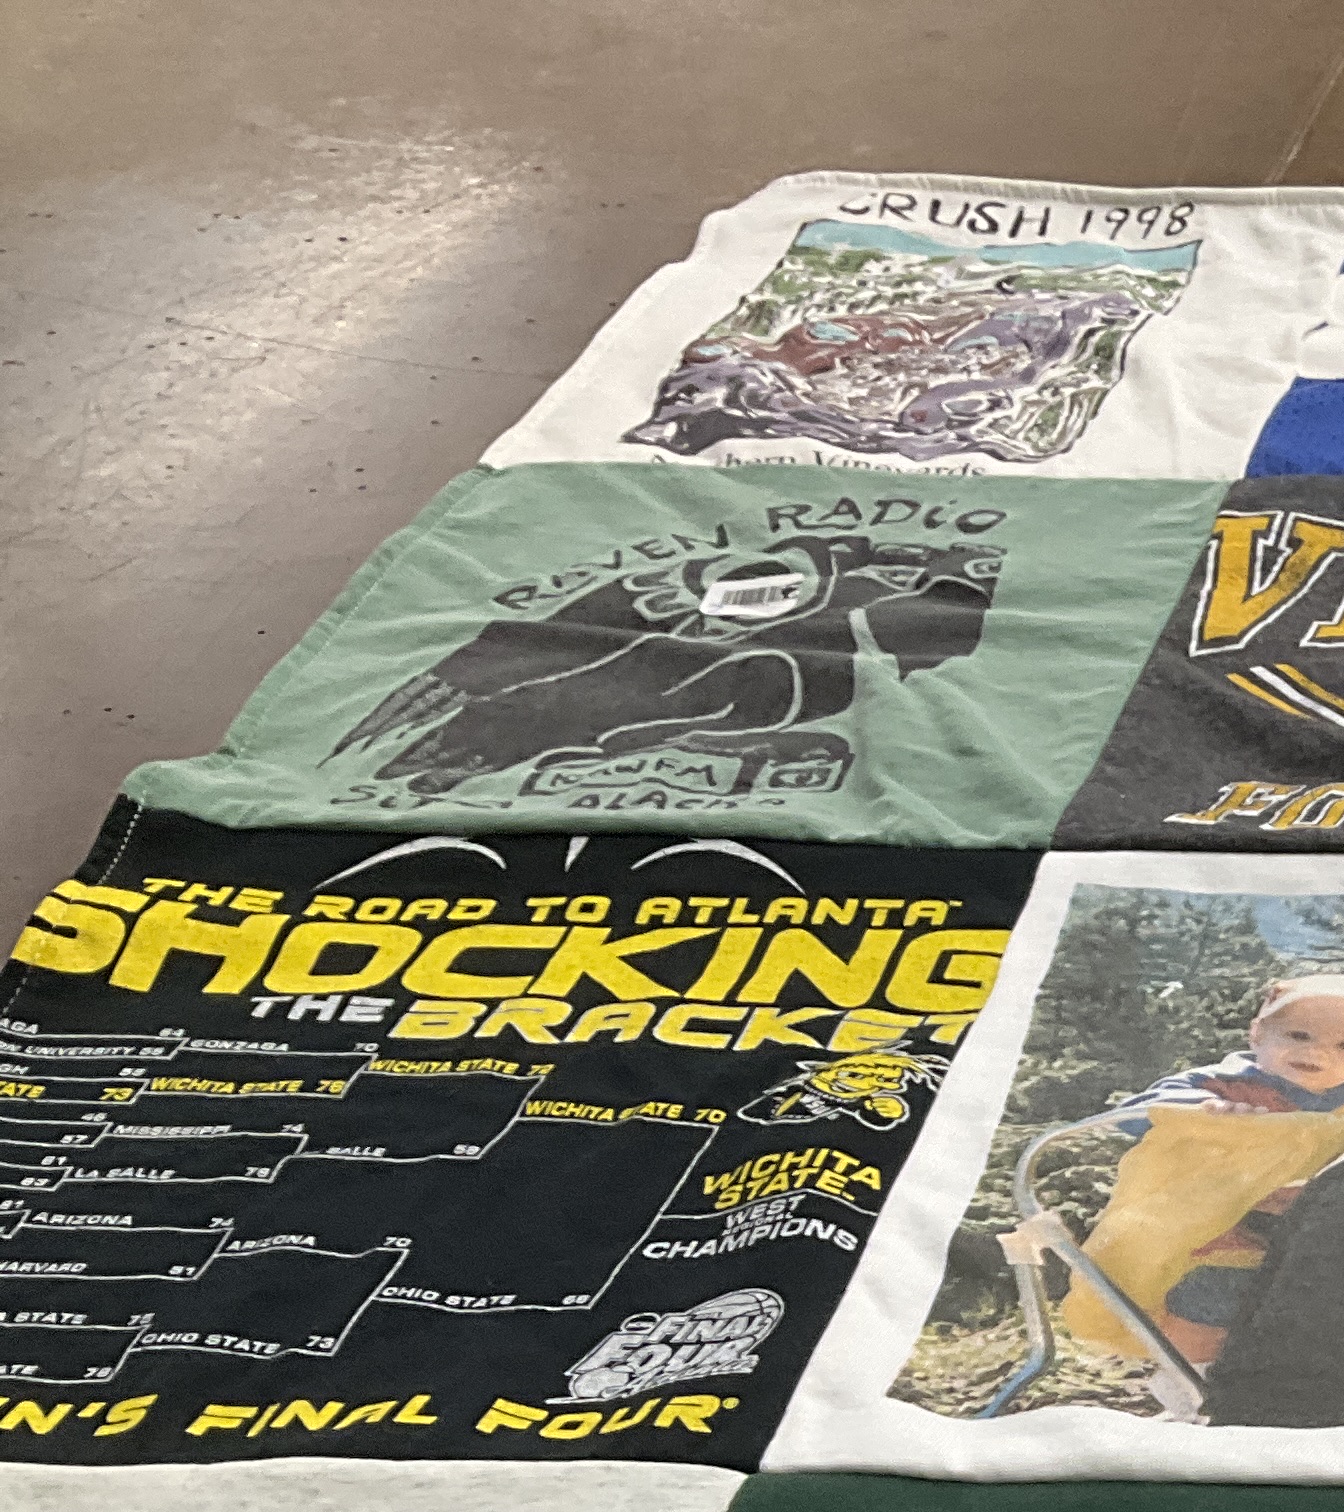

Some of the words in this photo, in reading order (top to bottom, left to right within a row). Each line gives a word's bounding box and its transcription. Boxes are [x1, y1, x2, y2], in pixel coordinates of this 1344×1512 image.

[1080, 200, 1196, 241] 1998
[142, 877, 284, 914] THE
[303, 894, 497, 922] ROAD
[525, 896, 608, 923] TO
[10, 879, 1012, 1014] SHOCKING
[250, 995, 395, 1023] THE
[189, 1039, 290, 1051] GONZAGA
[354, 1042, 380, 1053] 70
[369, 1058, 456, 1074] WICHITA
[456, 1058, 520, 1075] STATE
[99, 1086, 134, 1101] 73
[151, 1077, 237, 1094] WICHITA
[237, 1080, 305, 1094] STATE
[314, 1080, 347, 1094] 76
[524, 1100, 615, 1122] WICHITA
[694, 1108, 727, 1124] 70
[59, 1134, 89, 1145] 57
[112, 1124, 233, 1136] MISSISSIPPI
[74, 1168, 100, 1179] LA
[106, 1167, 176, 1180] SALLE
[702, 1148, 882, 1196] WICHITA
[714, 1167, 850, 1210] STATE
[32, 1211, 134, 1226] ARIZONA
[725, 1194, 807, 1228] WEST
[226, 1233, 318, 1251] ARIZONA
[382, 1235, 413, 1248] 70
[642, 1218, 859, 1260] CHAMPIONS
[382, 1285, 442, 1301] OHIO
[444, 1294, 518, 1309] STATE
[14, 1312, 88, 1325] STATE
[141, 1332, 200, 1345] OHIO
[204, 1335, 282, 1354] STATE
[305, 1335, 337, 1350] 73
[185, 1395, 438, 1438] FINAL
[475, 1394, 722, 1441] FOUR
